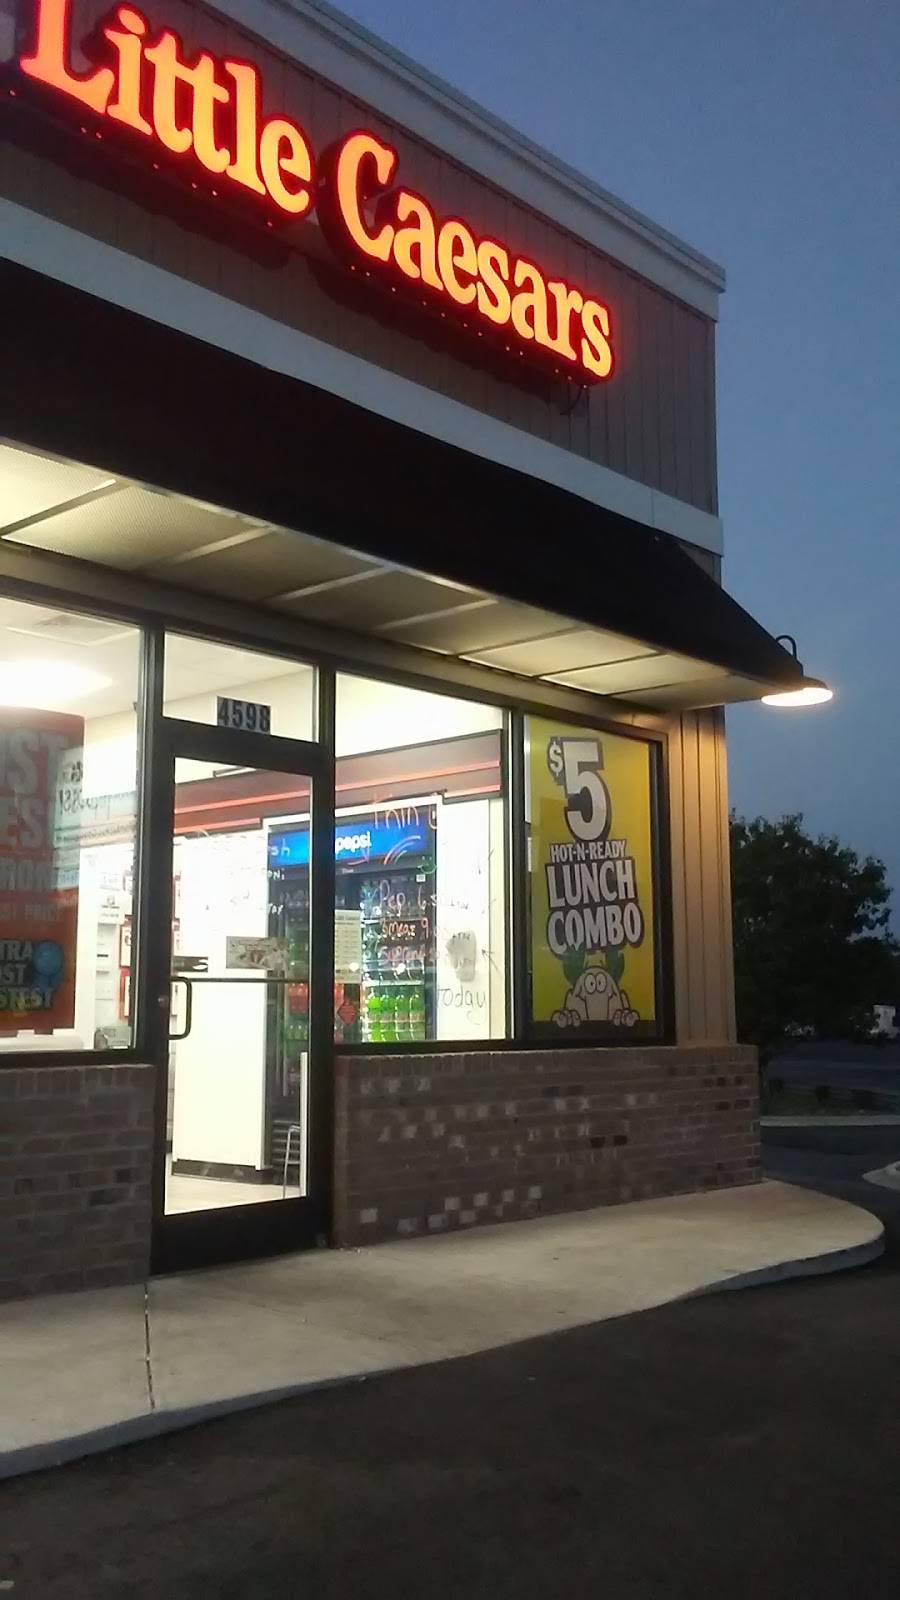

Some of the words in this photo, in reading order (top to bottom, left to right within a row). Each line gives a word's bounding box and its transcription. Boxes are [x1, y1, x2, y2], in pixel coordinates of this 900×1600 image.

[20, 0, 312, 214] Little
[336, 133, 613, 378] Caesars
[217, 697, 270, 733] 4598
[335, 830, 372, 855] pepsi
[550, 839, 627, 864] HOT-N-READY
[545, 859, 637, 909] LUNCH
[548, 902, 643, 956] COMBO
[0, 963, 27, 985] ST
